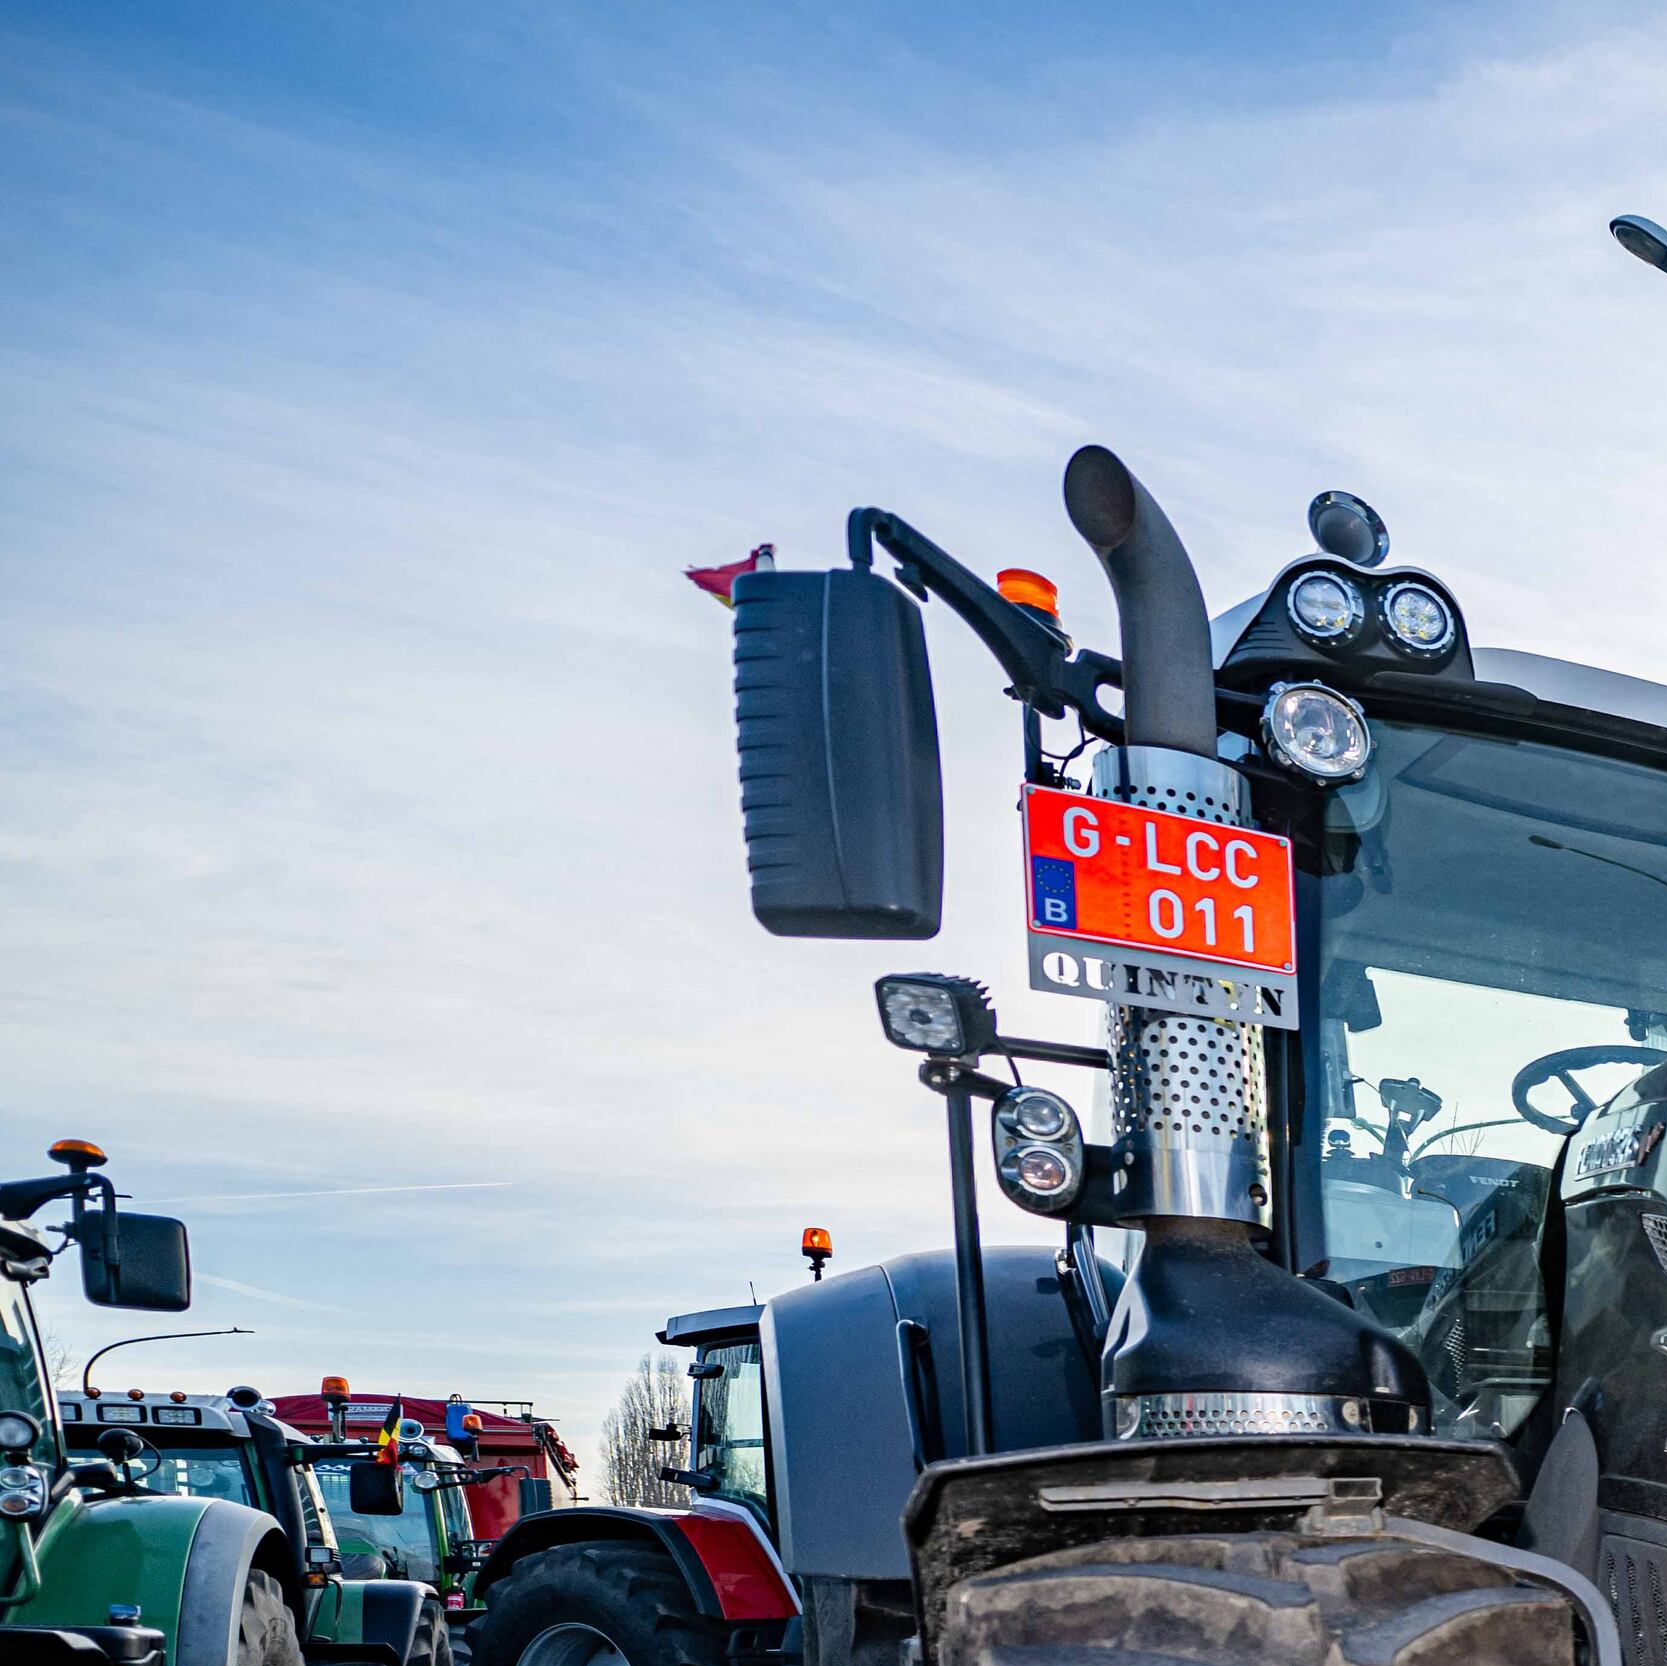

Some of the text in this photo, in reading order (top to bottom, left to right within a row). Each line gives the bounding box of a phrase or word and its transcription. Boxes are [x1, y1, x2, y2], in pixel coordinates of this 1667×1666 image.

[1063, 806, 1259, 889] G-LCC
[1044, 897, 1069, 923] B
[1148, 888, 1255, 954] 011
[1042, 951, 1285, 1017] QUINTYN
[1469, 1175, 1520, 1188] FENDT
